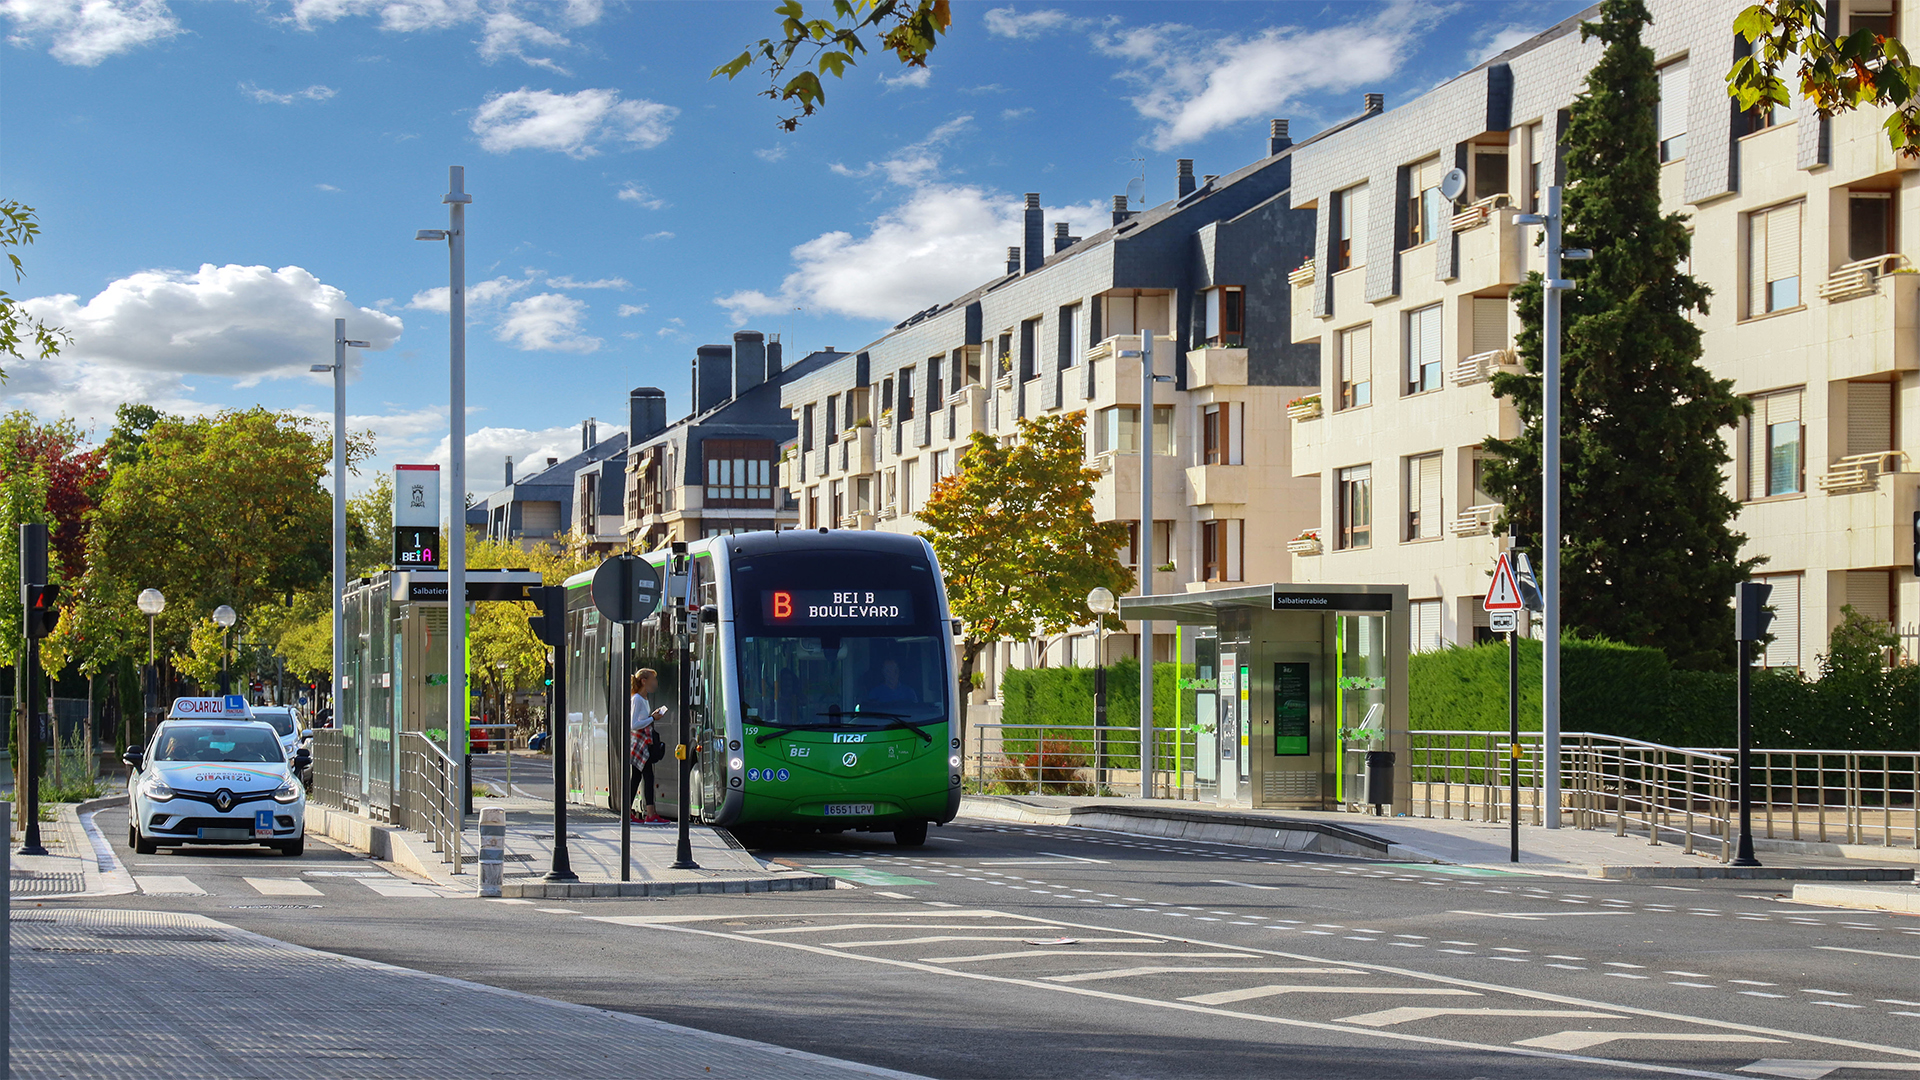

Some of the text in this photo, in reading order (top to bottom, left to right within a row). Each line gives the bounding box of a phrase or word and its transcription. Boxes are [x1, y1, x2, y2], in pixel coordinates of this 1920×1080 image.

[414, 532, 421, 548] 1
[422, 548, 432, 562] A
[833, 592, 875, 604] BEI B
[774, 592, 792, 618] B
[808, 605, 899, 618] BOULEVARD
[229, 697, 239, 708] L
[745, 727, 759, 735] 159
[833, 733, 868, 743] Irizar
[829, 805, 873, 815] 6551 LPV
[260, 813, 269, 827] L
